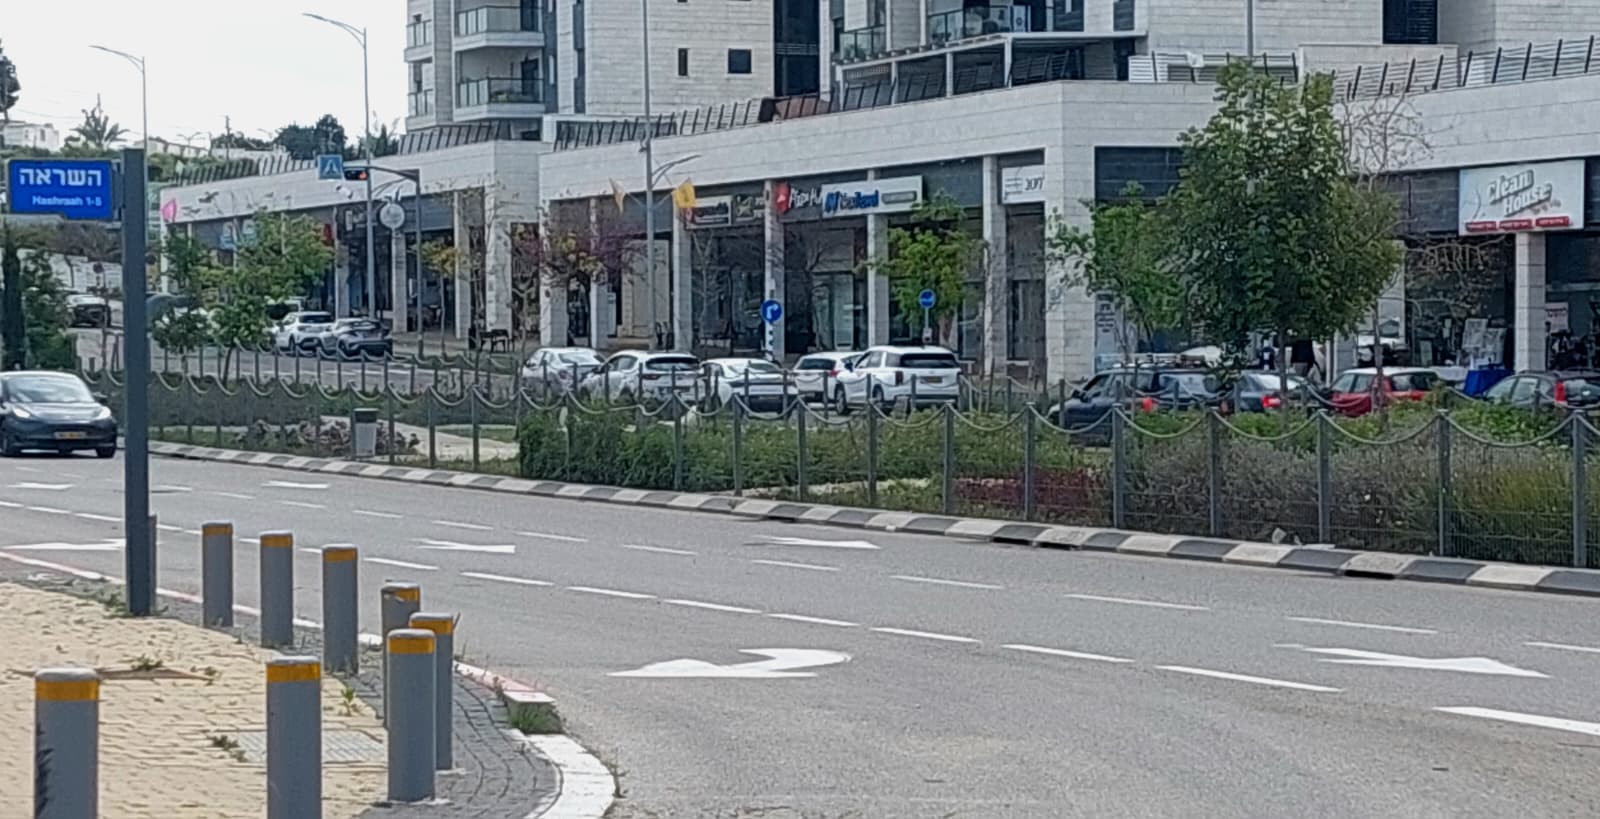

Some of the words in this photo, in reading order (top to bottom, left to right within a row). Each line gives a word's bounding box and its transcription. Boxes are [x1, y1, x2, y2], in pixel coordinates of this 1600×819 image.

[19, 168, 102, 187] השראה
[1487, 169, 1535, 205] Clean
[1503, 182, 1553, 218] House
